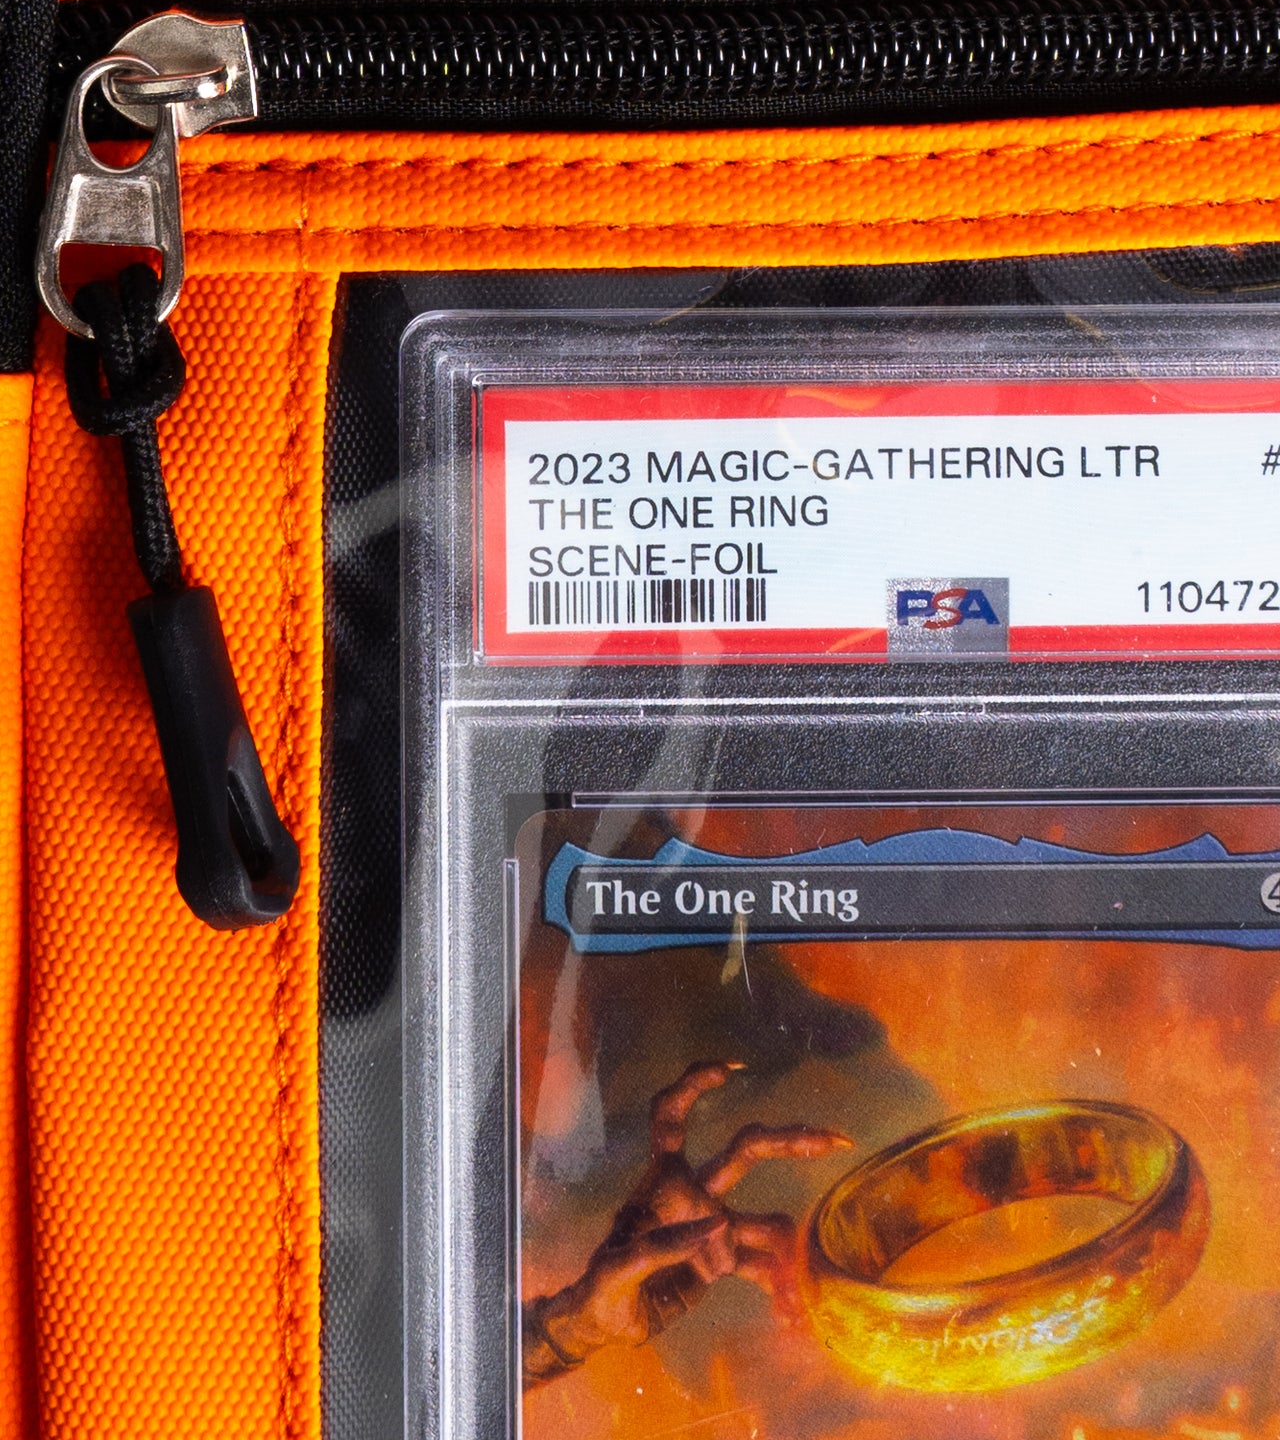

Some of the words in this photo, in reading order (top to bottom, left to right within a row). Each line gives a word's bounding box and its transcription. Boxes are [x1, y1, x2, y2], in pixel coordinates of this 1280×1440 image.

[529, 452, 631, 485] 2023
[646, 445, 1065, 483] MAGIC-GATHERING
[1080, 445, 1160, 478] LTR
[531, 498, 613, 530] THE
[629, 496, 714, 530] ONE
[730, 494, 829, 528] RING
[530, 542, 778, 577] SCENE-FOIL
[897, 587, 1000, 630] PSA
[586, 880, 661, 915] The
[674, 880, 756, 915] One
[770, 879, 859, 922] Ring
